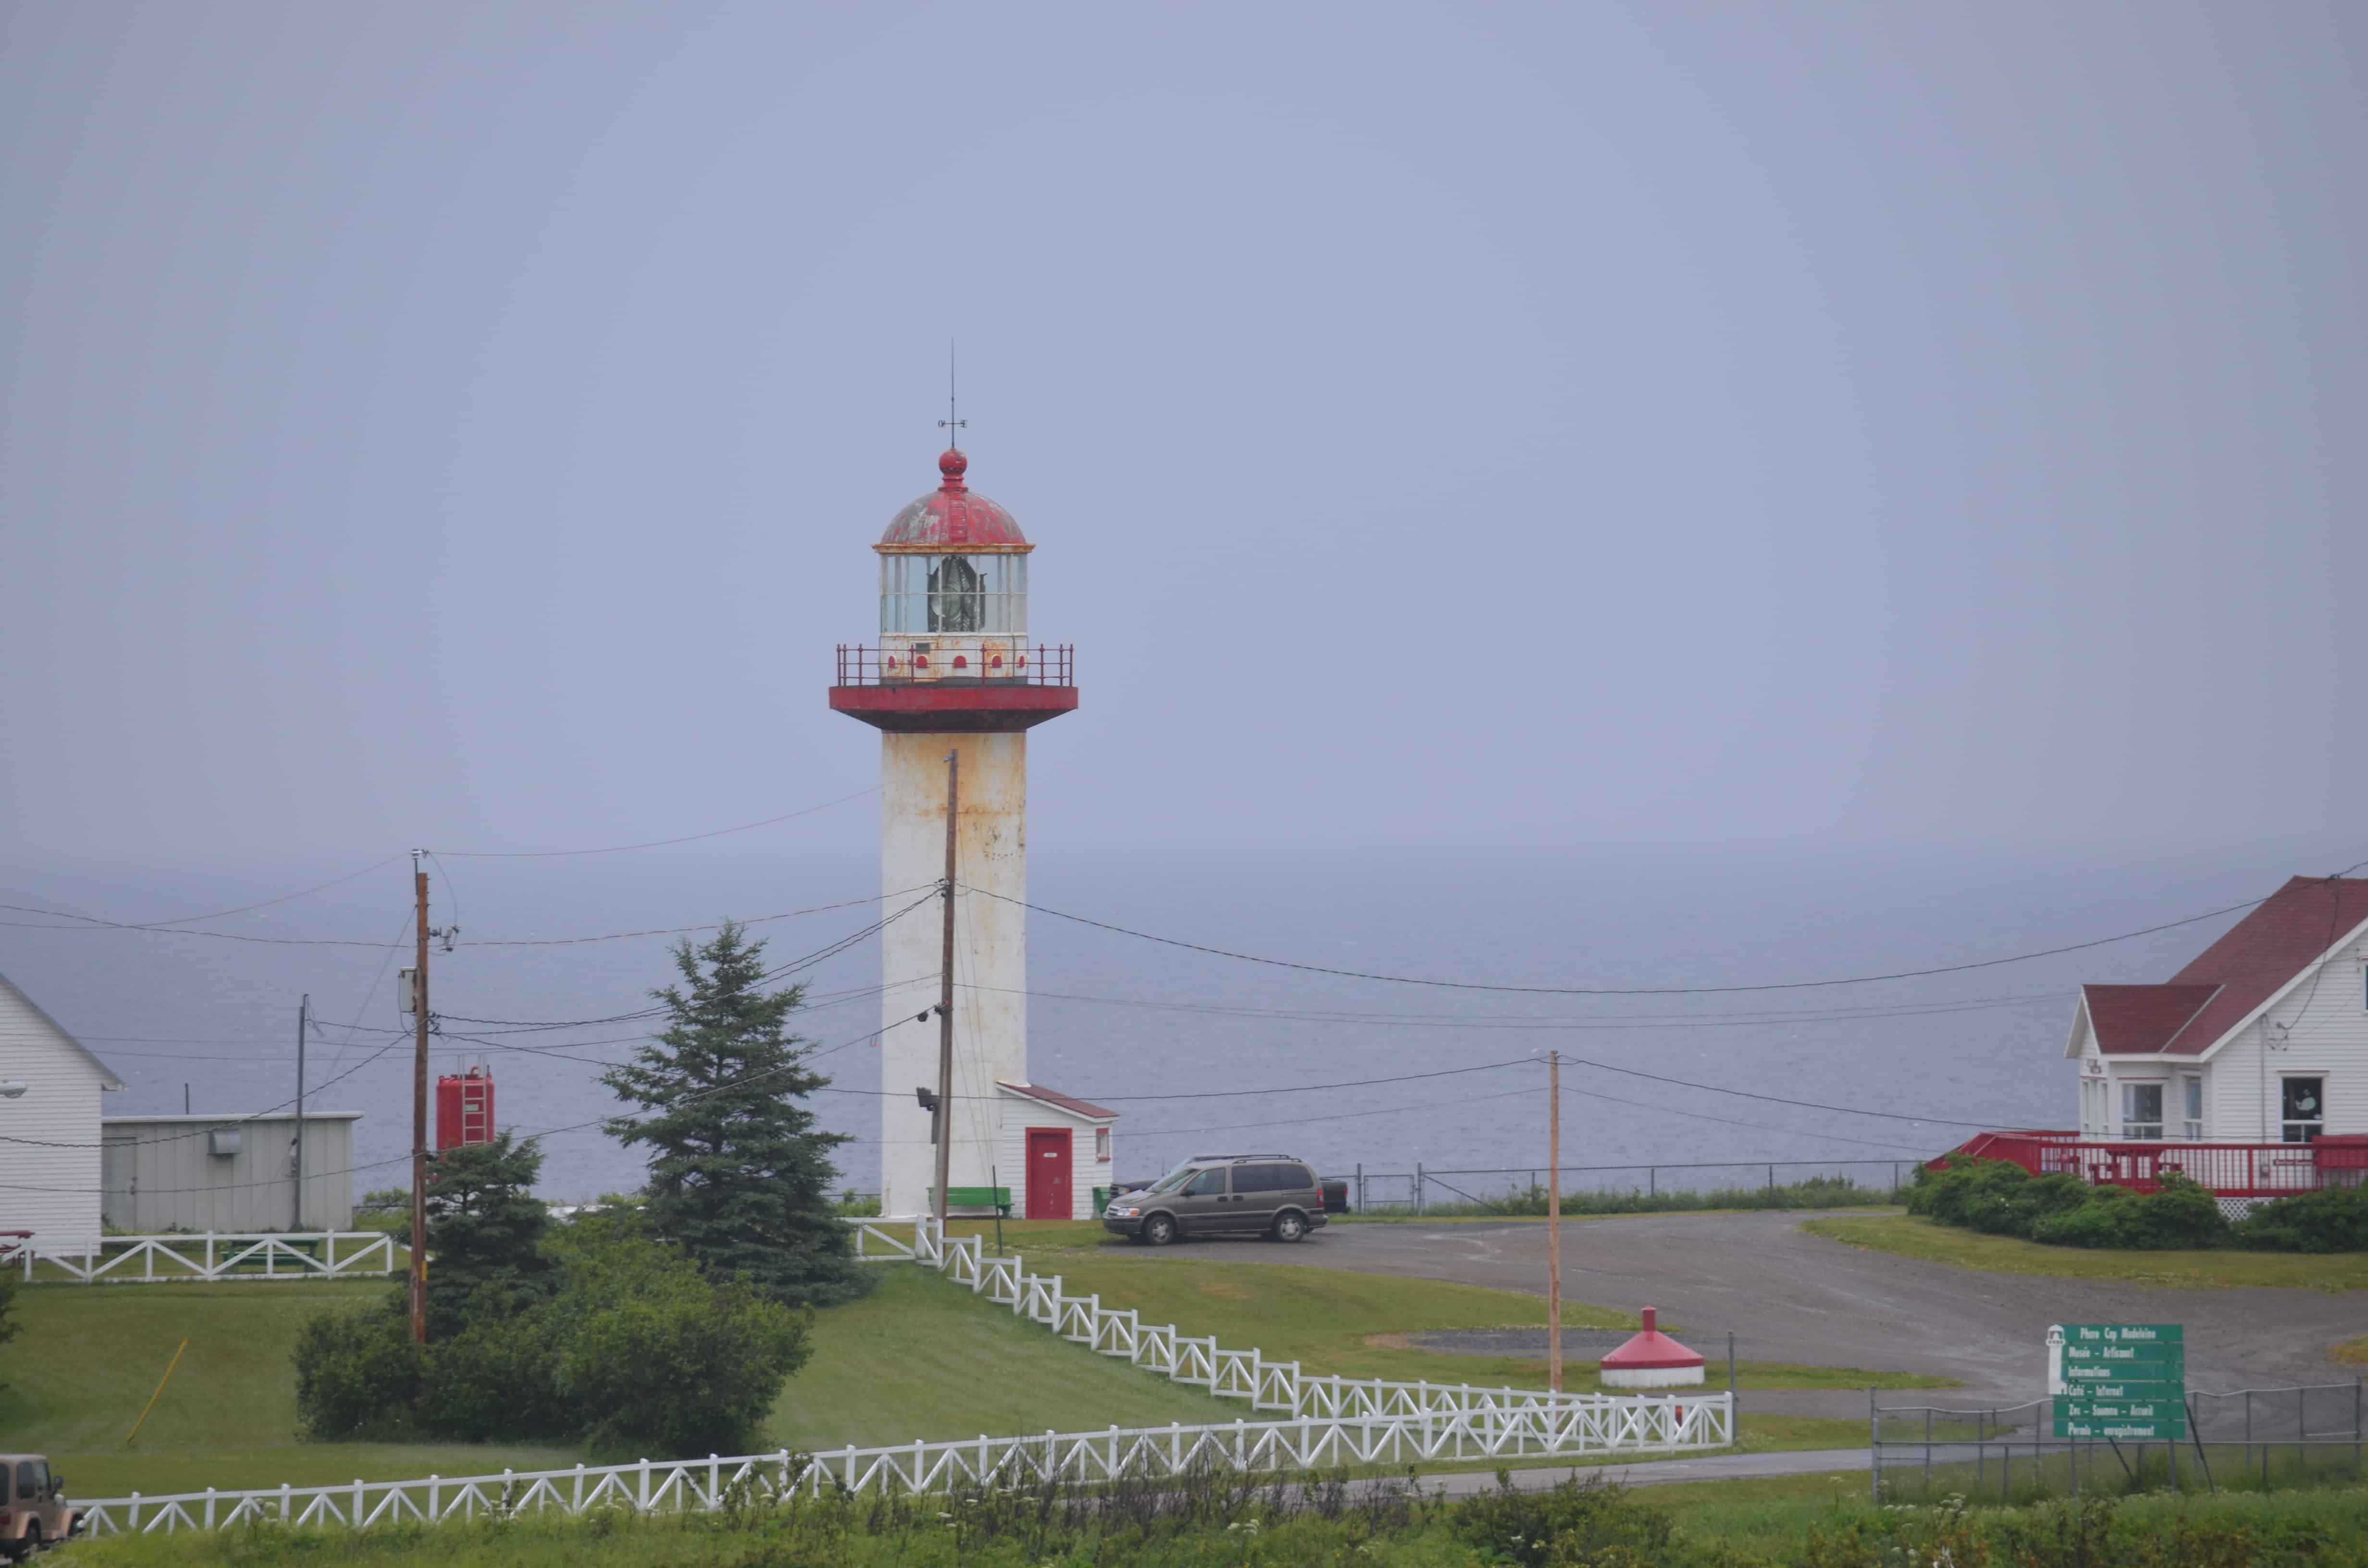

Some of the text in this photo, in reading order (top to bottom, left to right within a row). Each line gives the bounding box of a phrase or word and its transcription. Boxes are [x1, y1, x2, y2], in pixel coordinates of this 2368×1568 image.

[2080, 1327, 2156, 1342] Phare Cap Madeleine
[2068, 1366, 2110, 1377] Informations
[2069, 1384, 2084, 1396] Café
[2096, 1385, 2123, 1396] Internet
[2068, 1422, 2091, 1435] Permis
